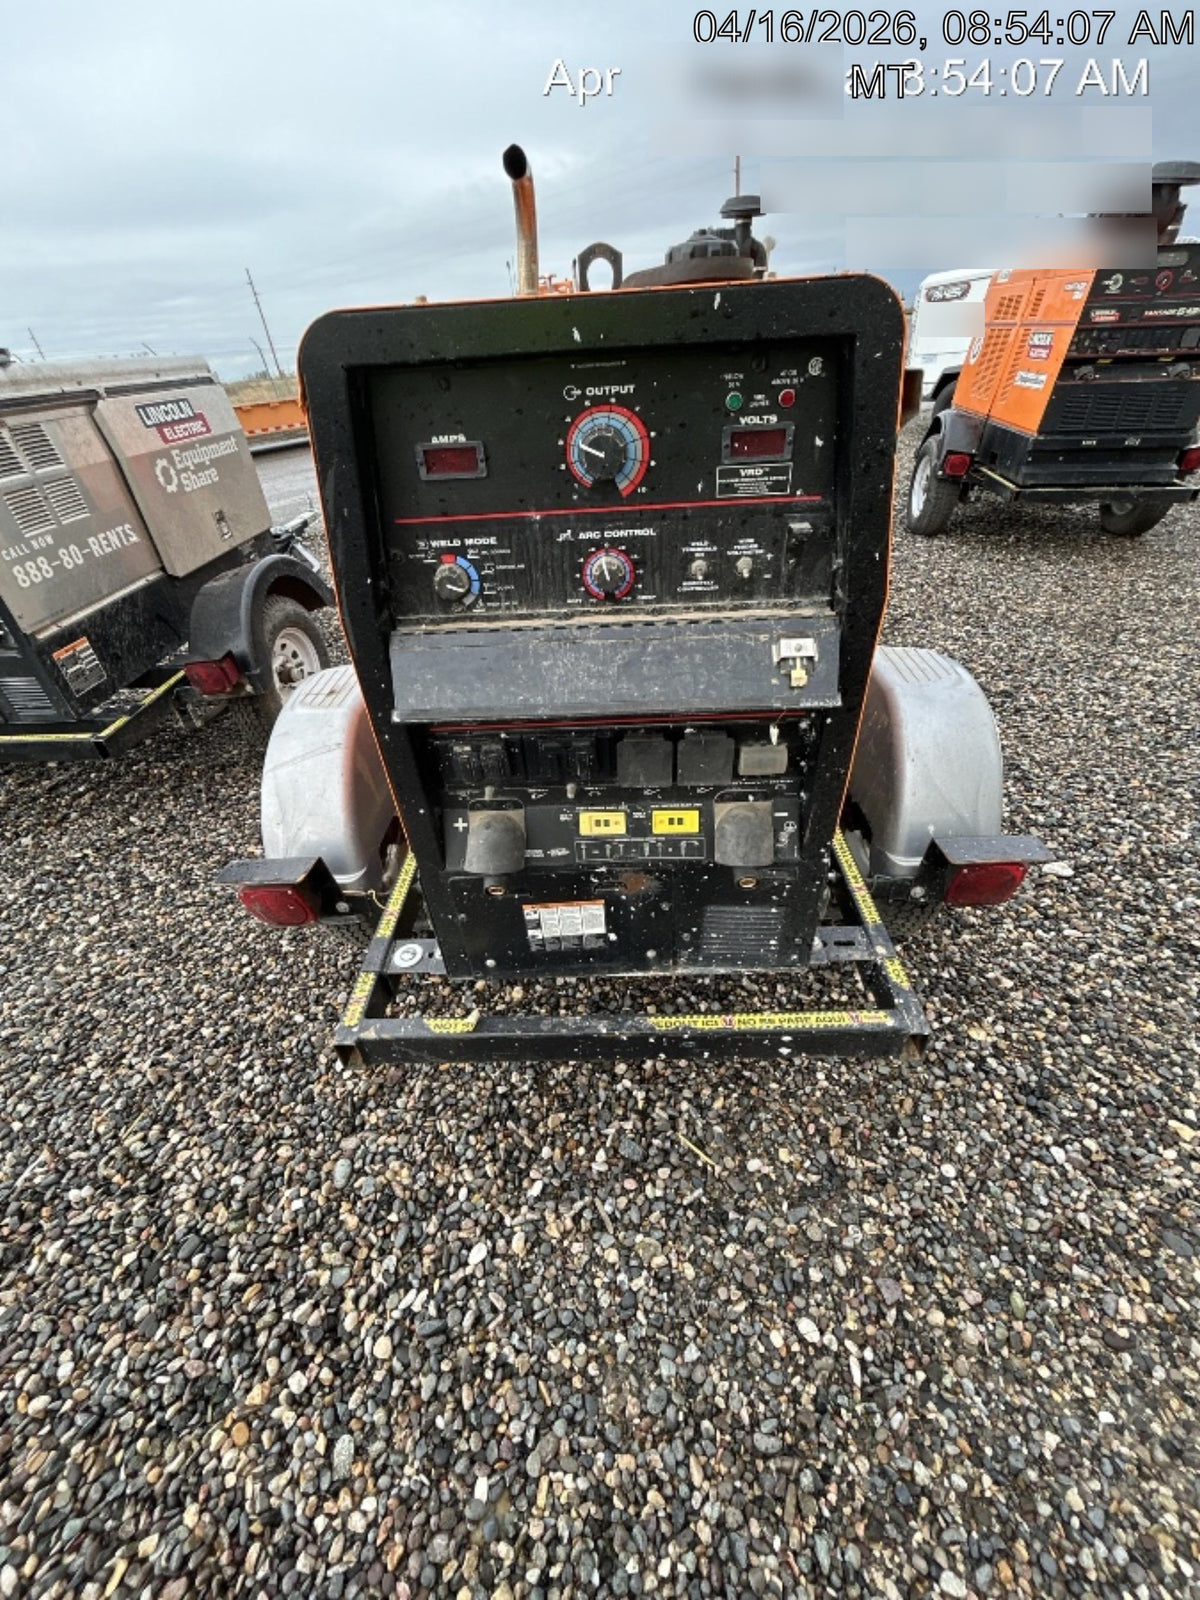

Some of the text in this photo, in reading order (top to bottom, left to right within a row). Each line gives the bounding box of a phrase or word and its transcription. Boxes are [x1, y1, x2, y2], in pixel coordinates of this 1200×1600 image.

[585, 384, 636, 396] OUTPUT
[138, 401, 195, 426] LINCOLN
[739, 414, 778, 426] VOLTS
[163, 420, 207, 440] ELECTRIC
[431, 433, 467, 444] AMPS
[170, 435, 239, 470] Equipment
[181, 467, 219, 492] Share
[430, 536, 498, 548] WELD MODE
[578, 528, 656, 539] ARC CONTROL
[1, 534, 54, 561] CALL NOW
[12, 523, 140, 588] 888-80-RENTS
